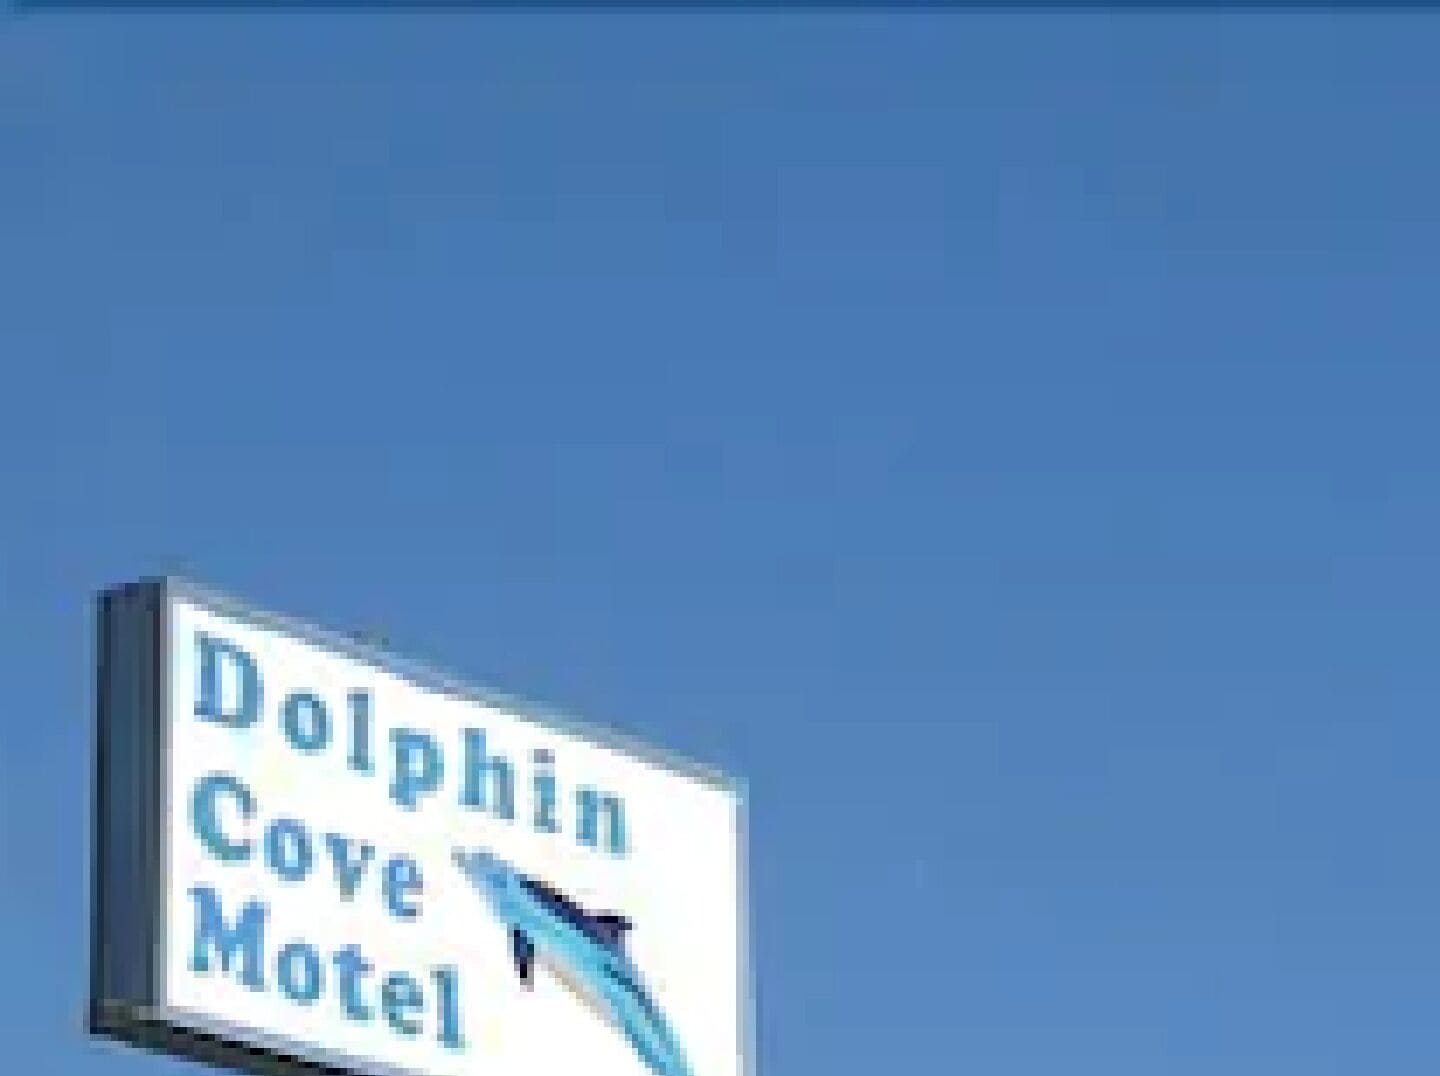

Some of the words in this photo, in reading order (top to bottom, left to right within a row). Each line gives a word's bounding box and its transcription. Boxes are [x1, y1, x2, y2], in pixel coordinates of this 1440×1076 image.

[193, 631, 632, 856] Dolphin
[187, 769, 423, 918] Cove
[188, 882, 465, 1049] Motel
